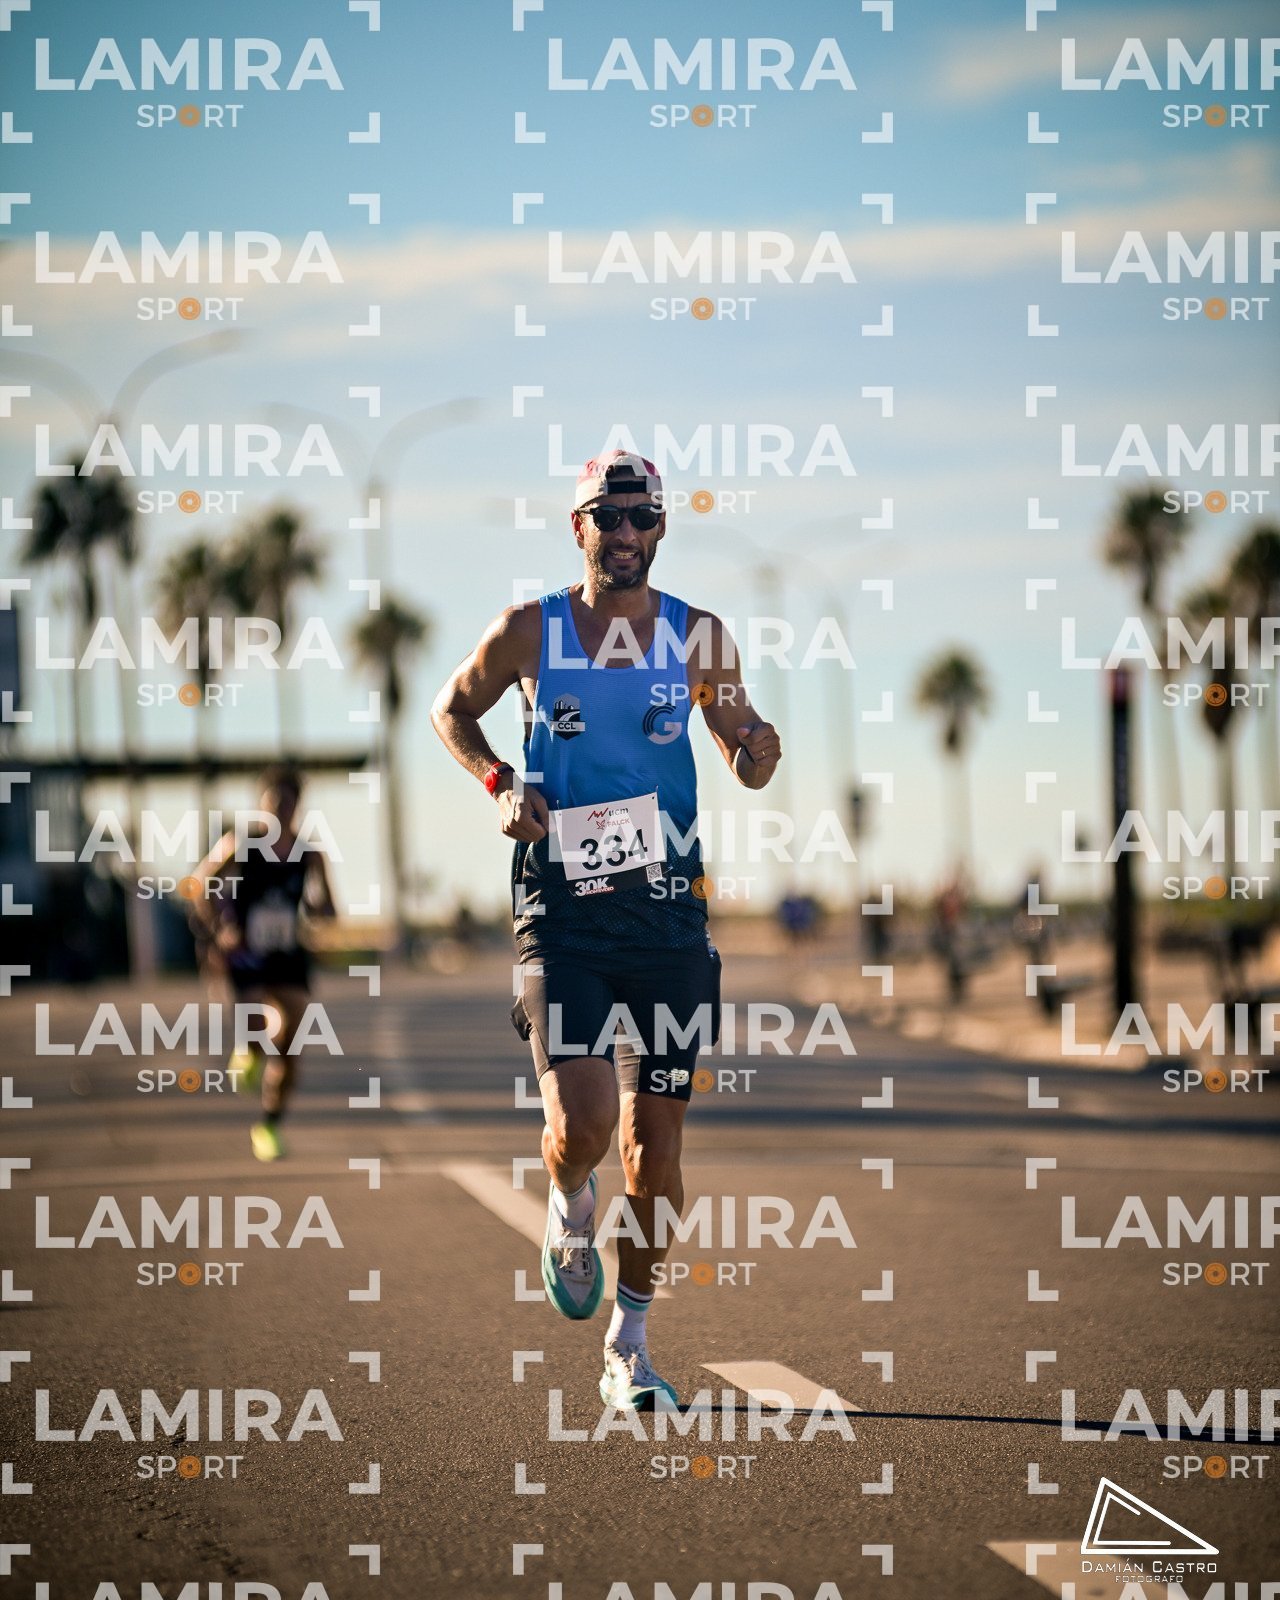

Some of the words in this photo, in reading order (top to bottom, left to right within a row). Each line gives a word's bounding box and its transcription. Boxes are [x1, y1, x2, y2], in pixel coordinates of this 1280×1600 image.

[557, 722, 576, 730] CCL
[606, 818, 630, 826] FALCK
[579, 828, 649, 871] 334
[575, 876, 610, 897] 30K
